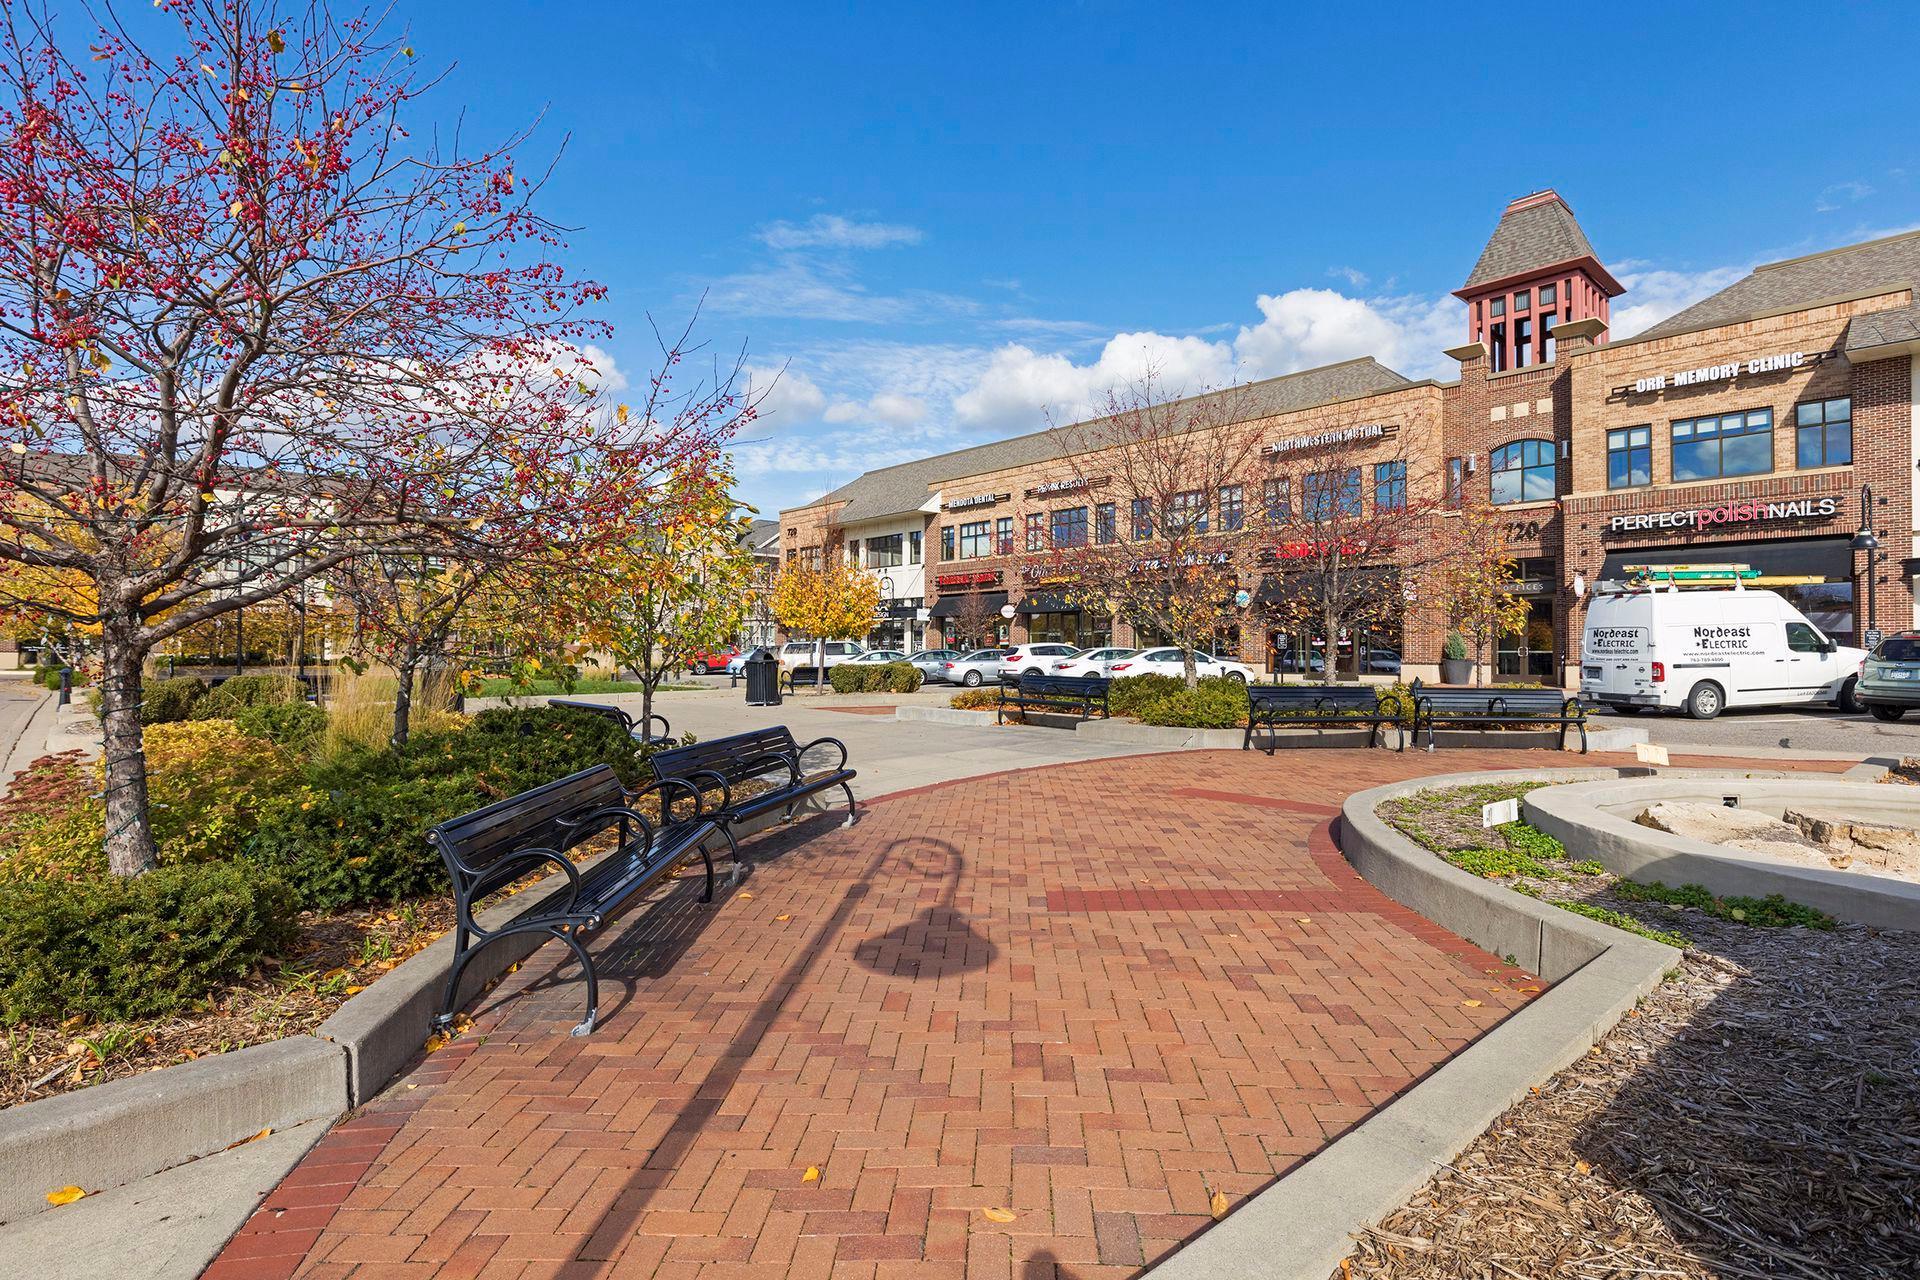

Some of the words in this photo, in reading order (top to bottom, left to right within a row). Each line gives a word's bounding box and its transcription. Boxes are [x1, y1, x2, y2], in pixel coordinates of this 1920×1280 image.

[1636, 375, 1666, 393] ORR
[1674, 362, 1741, 387] MEMORY
[1748, 351, 1804, 374] CLINIC
[1272, 431, 1343, 453] NORTHWESTERN
[1344, 424, 1383, 440] MUTUAL
[949, 497, 974, 508] MENDOTA
[974, 493, 995, 504] DENTAL
[1768, 498, 1836, 519] NAILS
[1504, 521, 1540, 543] 720
[1503, 583, 1544, 591] OFFICES
[1593, 629, 1639, 639] Nordeast
[1694, 626, 1751, 638] Nordeast
[1598, 638, 1635, 648] ELECTRIC
[1701, 639, 1748, 649] ELECTRIC
